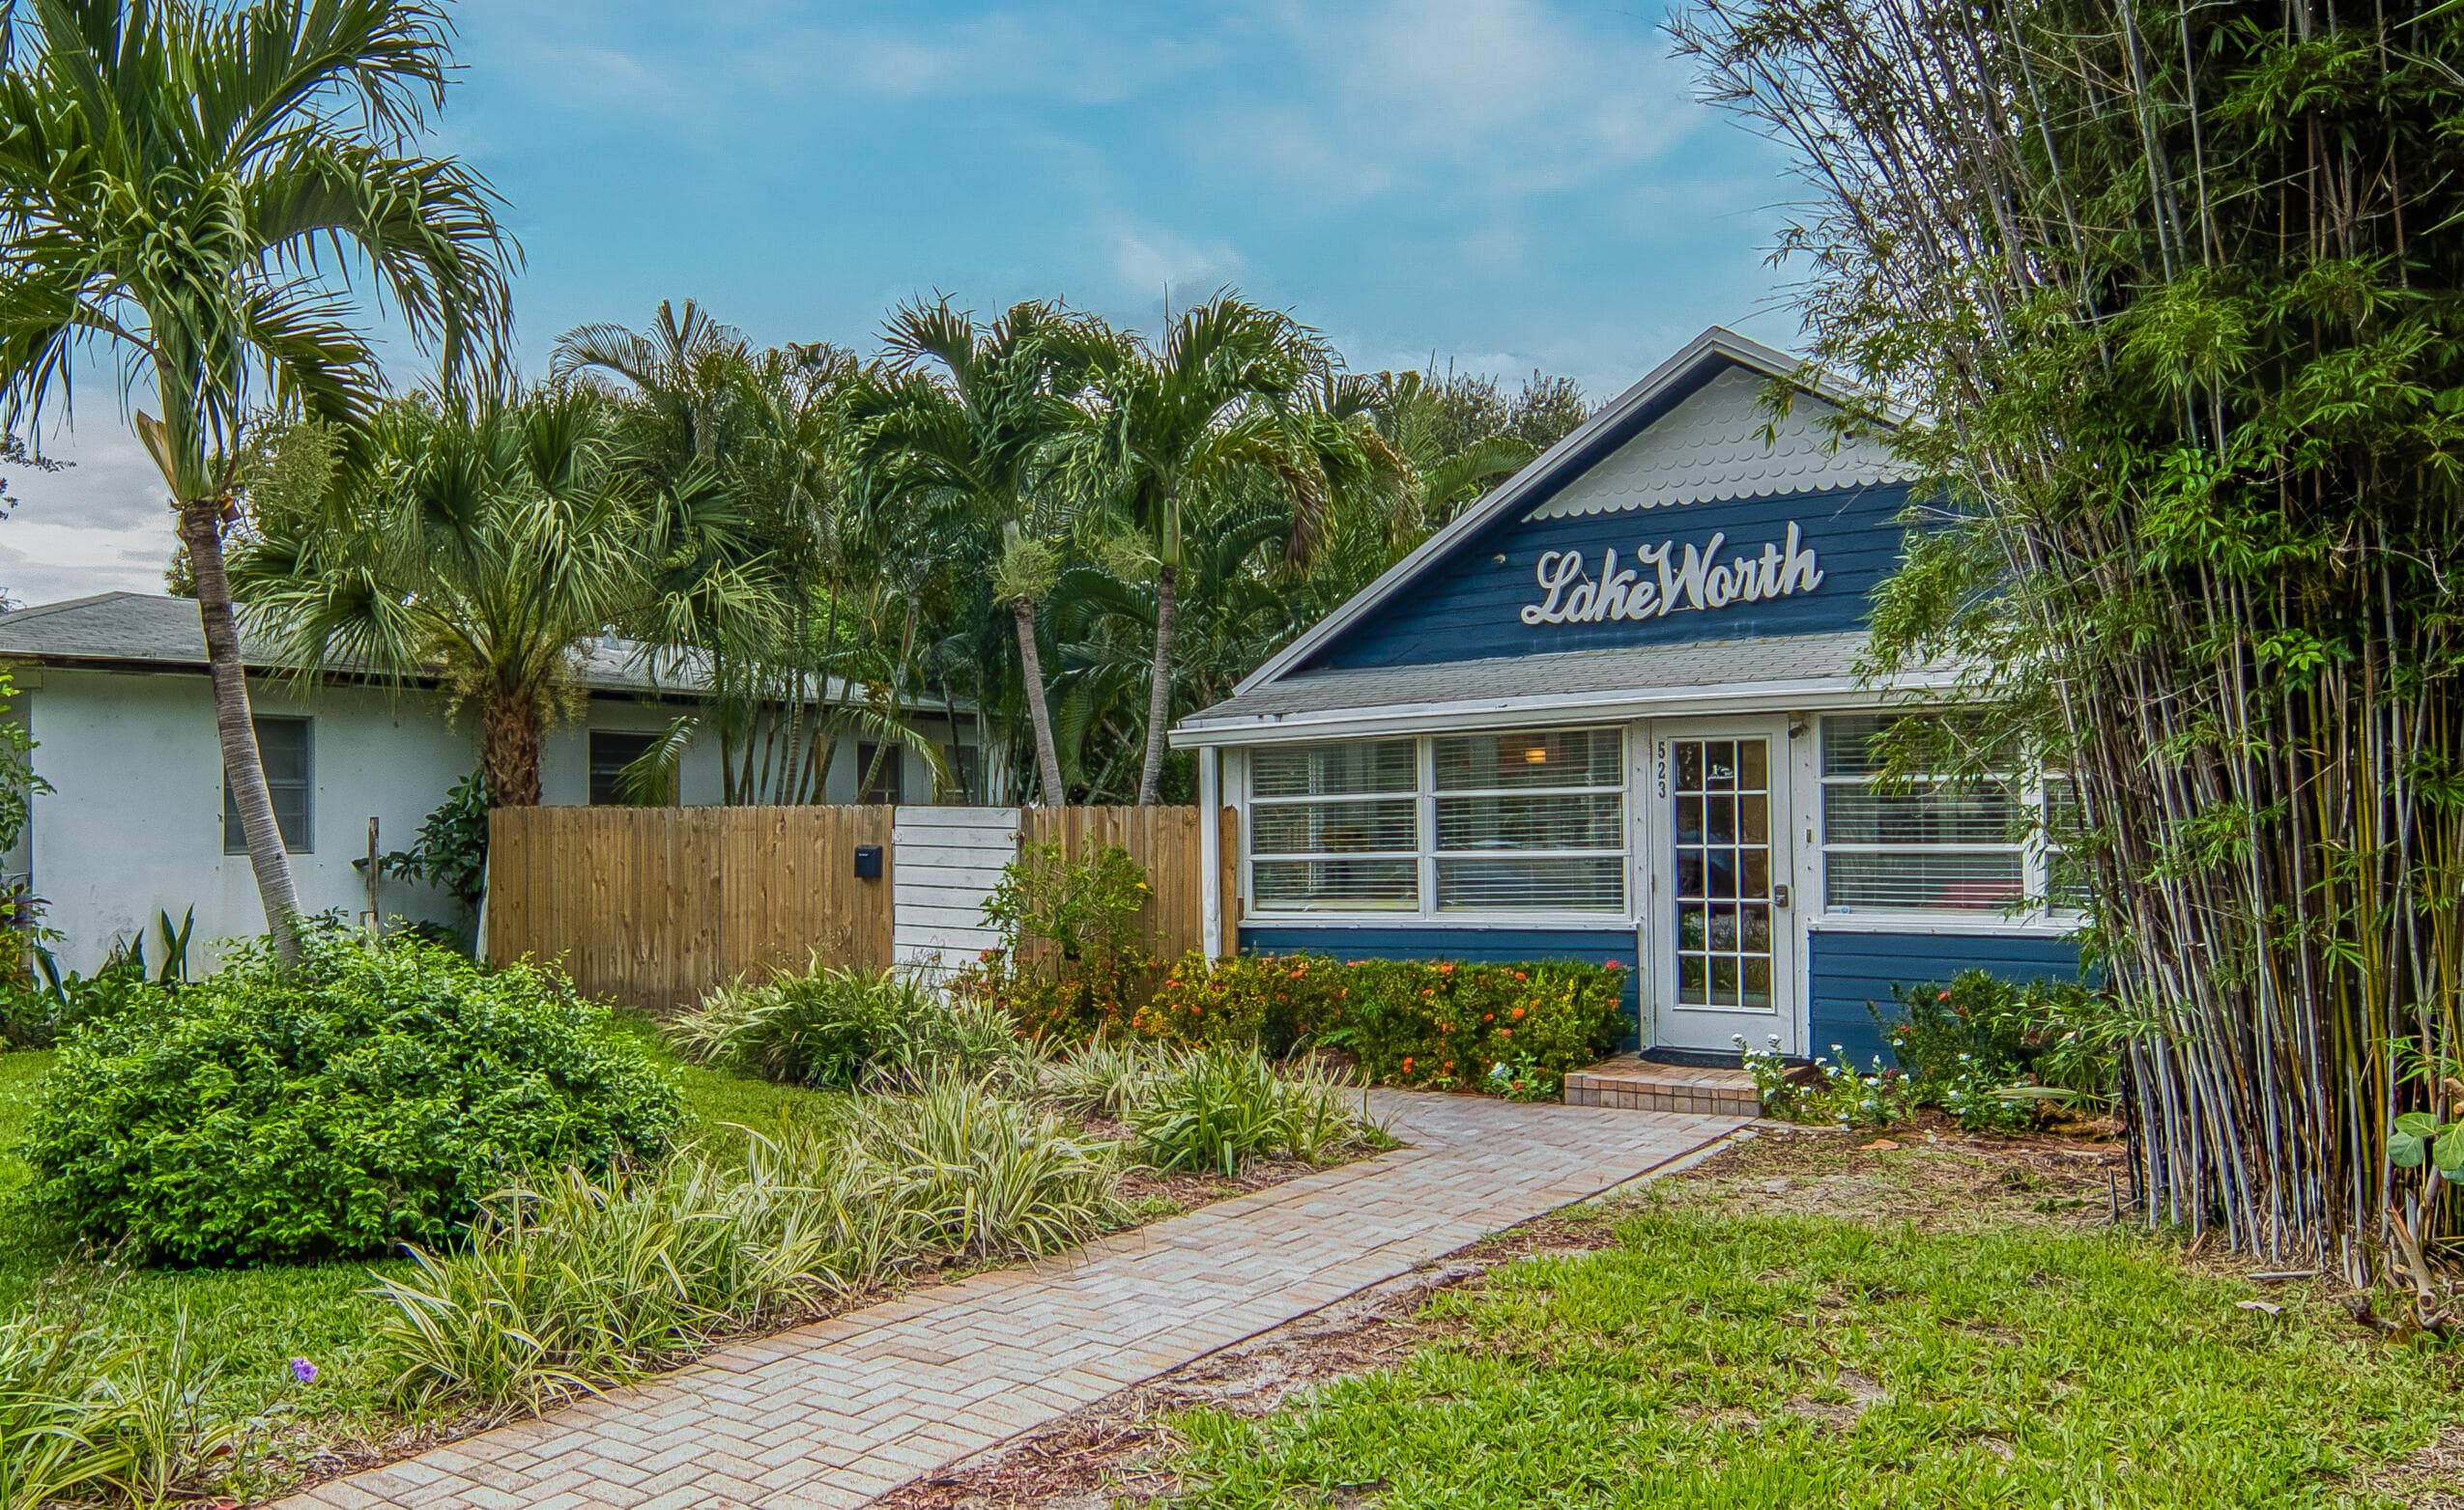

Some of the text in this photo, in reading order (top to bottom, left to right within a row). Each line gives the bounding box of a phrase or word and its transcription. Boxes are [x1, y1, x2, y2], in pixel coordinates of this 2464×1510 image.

[1520, 520, 1824, 625] Lake Worth
[1657, 741, 1666, 798] 523
